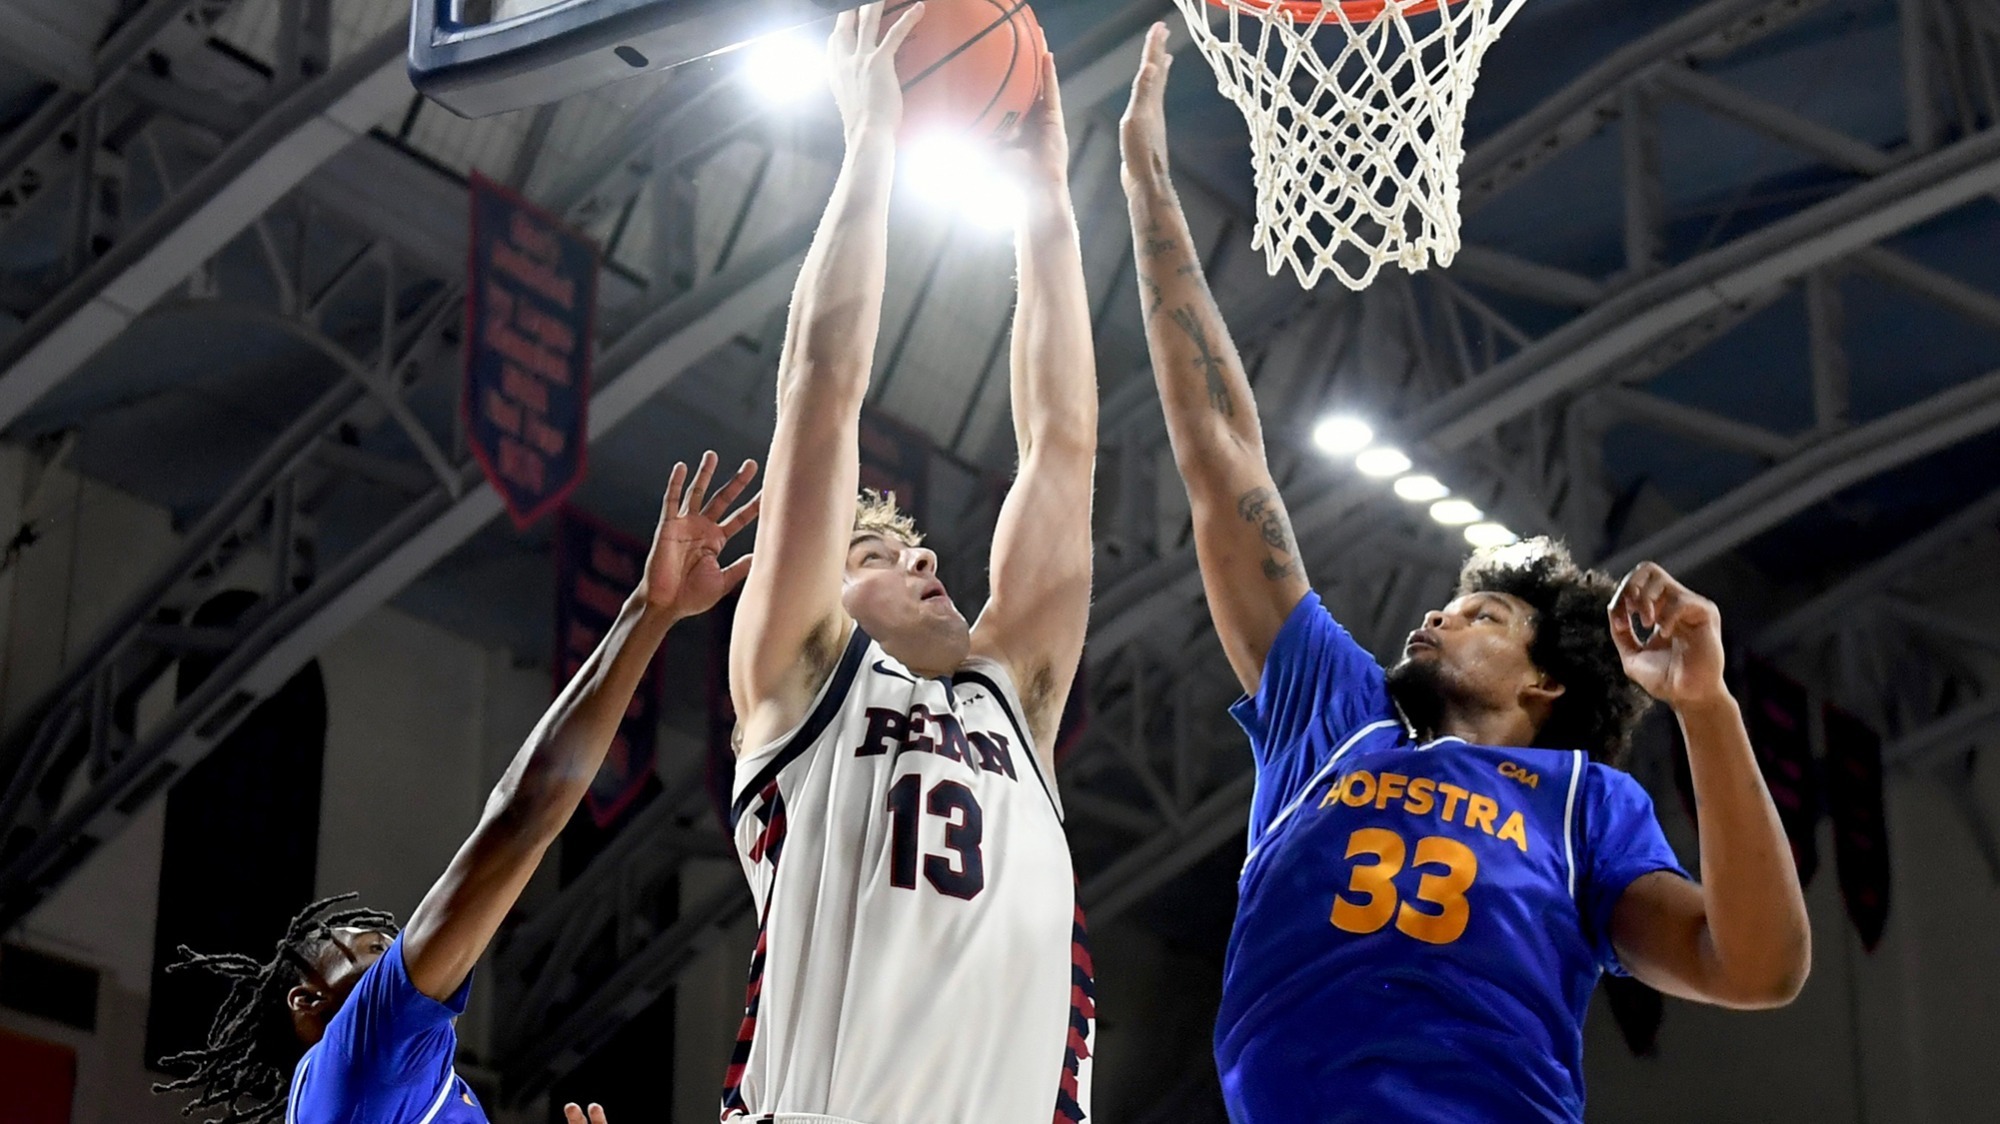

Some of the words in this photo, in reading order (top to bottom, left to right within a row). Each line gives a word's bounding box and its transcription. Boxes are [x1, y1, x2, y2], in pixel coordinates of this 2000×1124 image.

[854, 703, 1018, 783] PENN
[1498, 761, 1540, 789] CAA
[887, 774, 985, 902] 13
[1318, 770, 1527, 852] HOFSTRA
[1330, 828, 1478, 945] 33
